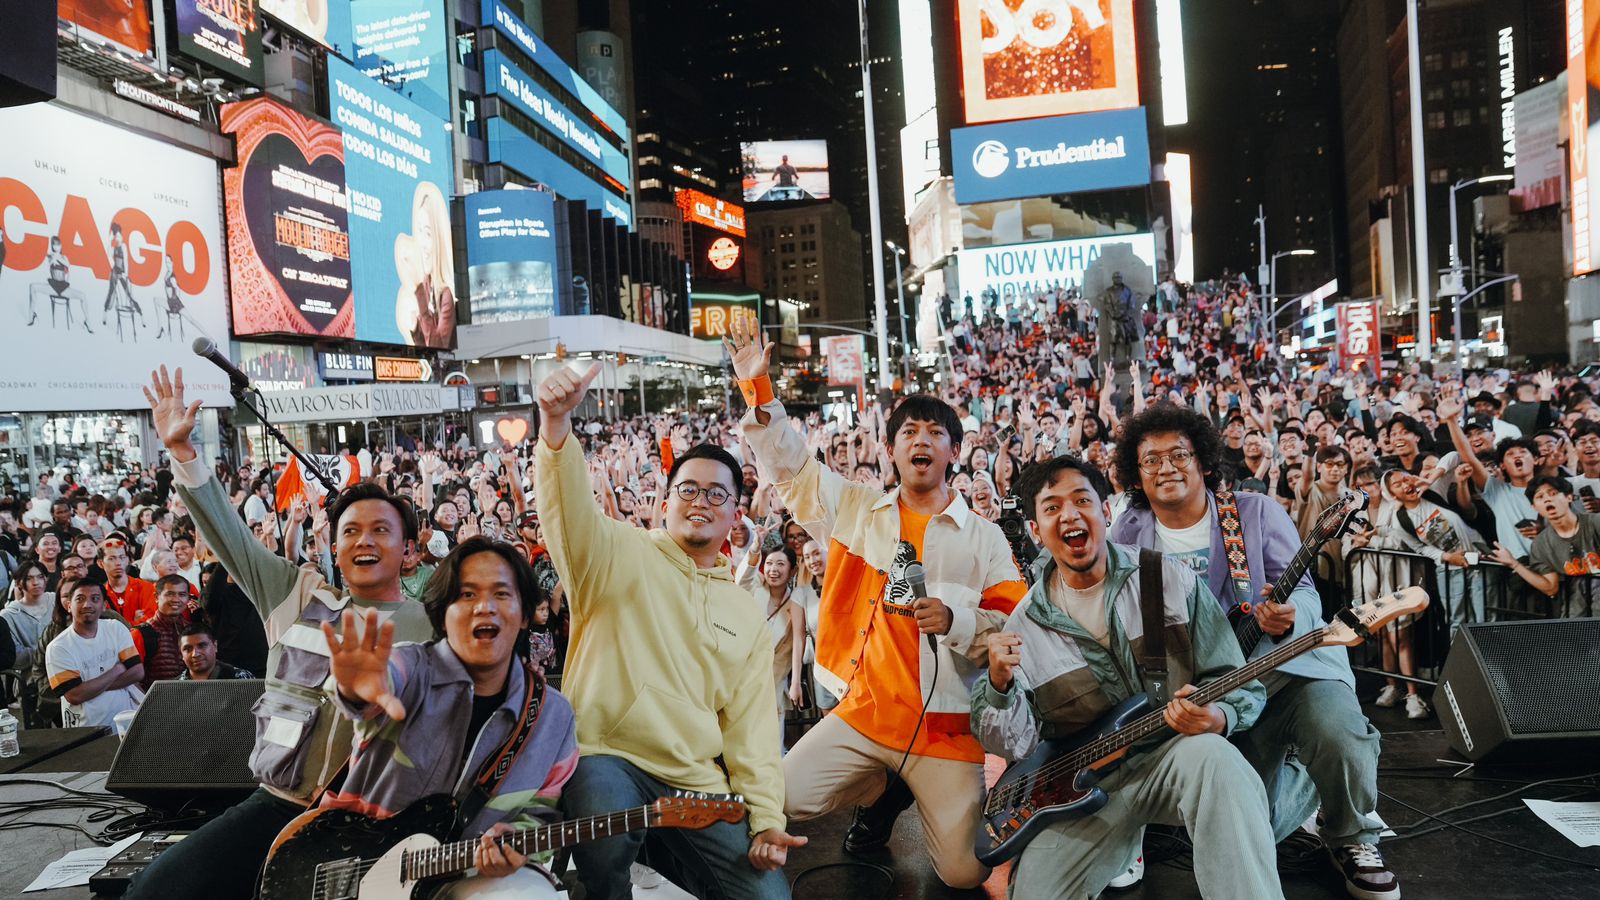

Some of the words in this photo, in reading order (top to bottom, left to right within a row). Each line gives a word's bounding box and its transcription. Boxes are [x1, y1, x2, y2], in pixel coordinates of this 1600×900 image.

[357, 47, 373, 59] your
[1498, 26, 1516, 99] MILLEN
[500, 63, 520, 98] Five
[335, 79, 373, 112] TODOS
[373, 100, 393, 123] LOS
[337, 105, 379, 139] COMIDA
[379, 126, 432, 164] SALUDABLE
[1502, 101, 1517, 168] KAREN
[376, 147, 396, 169] LOS
[1015, 136, 1127, 169] Prudential
[34, 159, 67, 175] UH-UH
[98, 176, 130, 192] CICERO
[985, 249, 1037, 277] NOW
[1044, 244, 1104, 272] WHA
[298, 270, 349, 289] BROADWAY
[325, 353, 353, 370] BLUE
[356, 355, 373, 370] FIN
[258, 392, 369, 415] SWAROVSKI
[372, 387, 441, 413] SWAROVSKI
[882, 603, 916, 618] uprem
